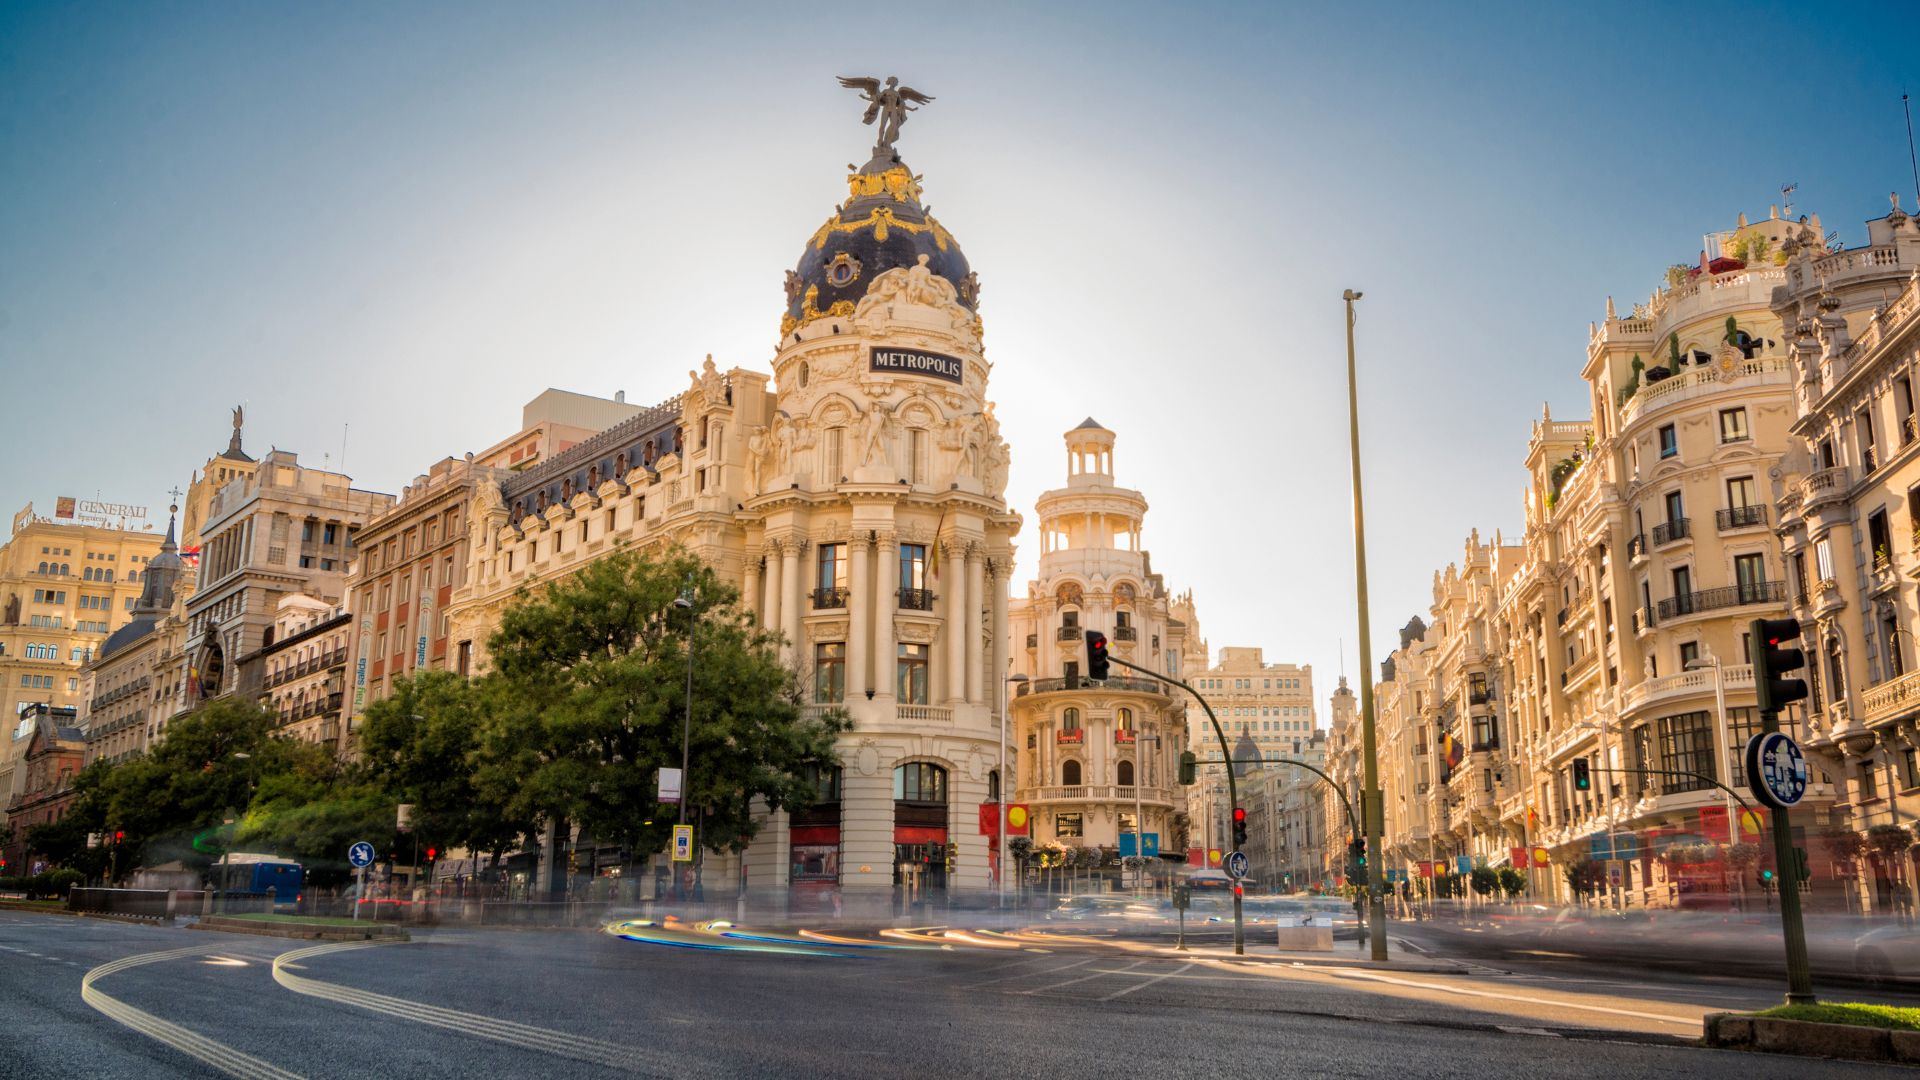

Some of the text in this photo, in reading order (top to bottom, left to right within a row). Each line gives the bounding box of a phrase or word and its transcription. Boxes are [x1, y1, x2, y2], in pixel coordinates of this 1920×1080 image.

[875, 352, 960, 377] METROPOLIS
[79, 500, 148, 518] GENERALI
[417, 637, 426, 666] salida
[354, 658, 367, 705] hay salida
